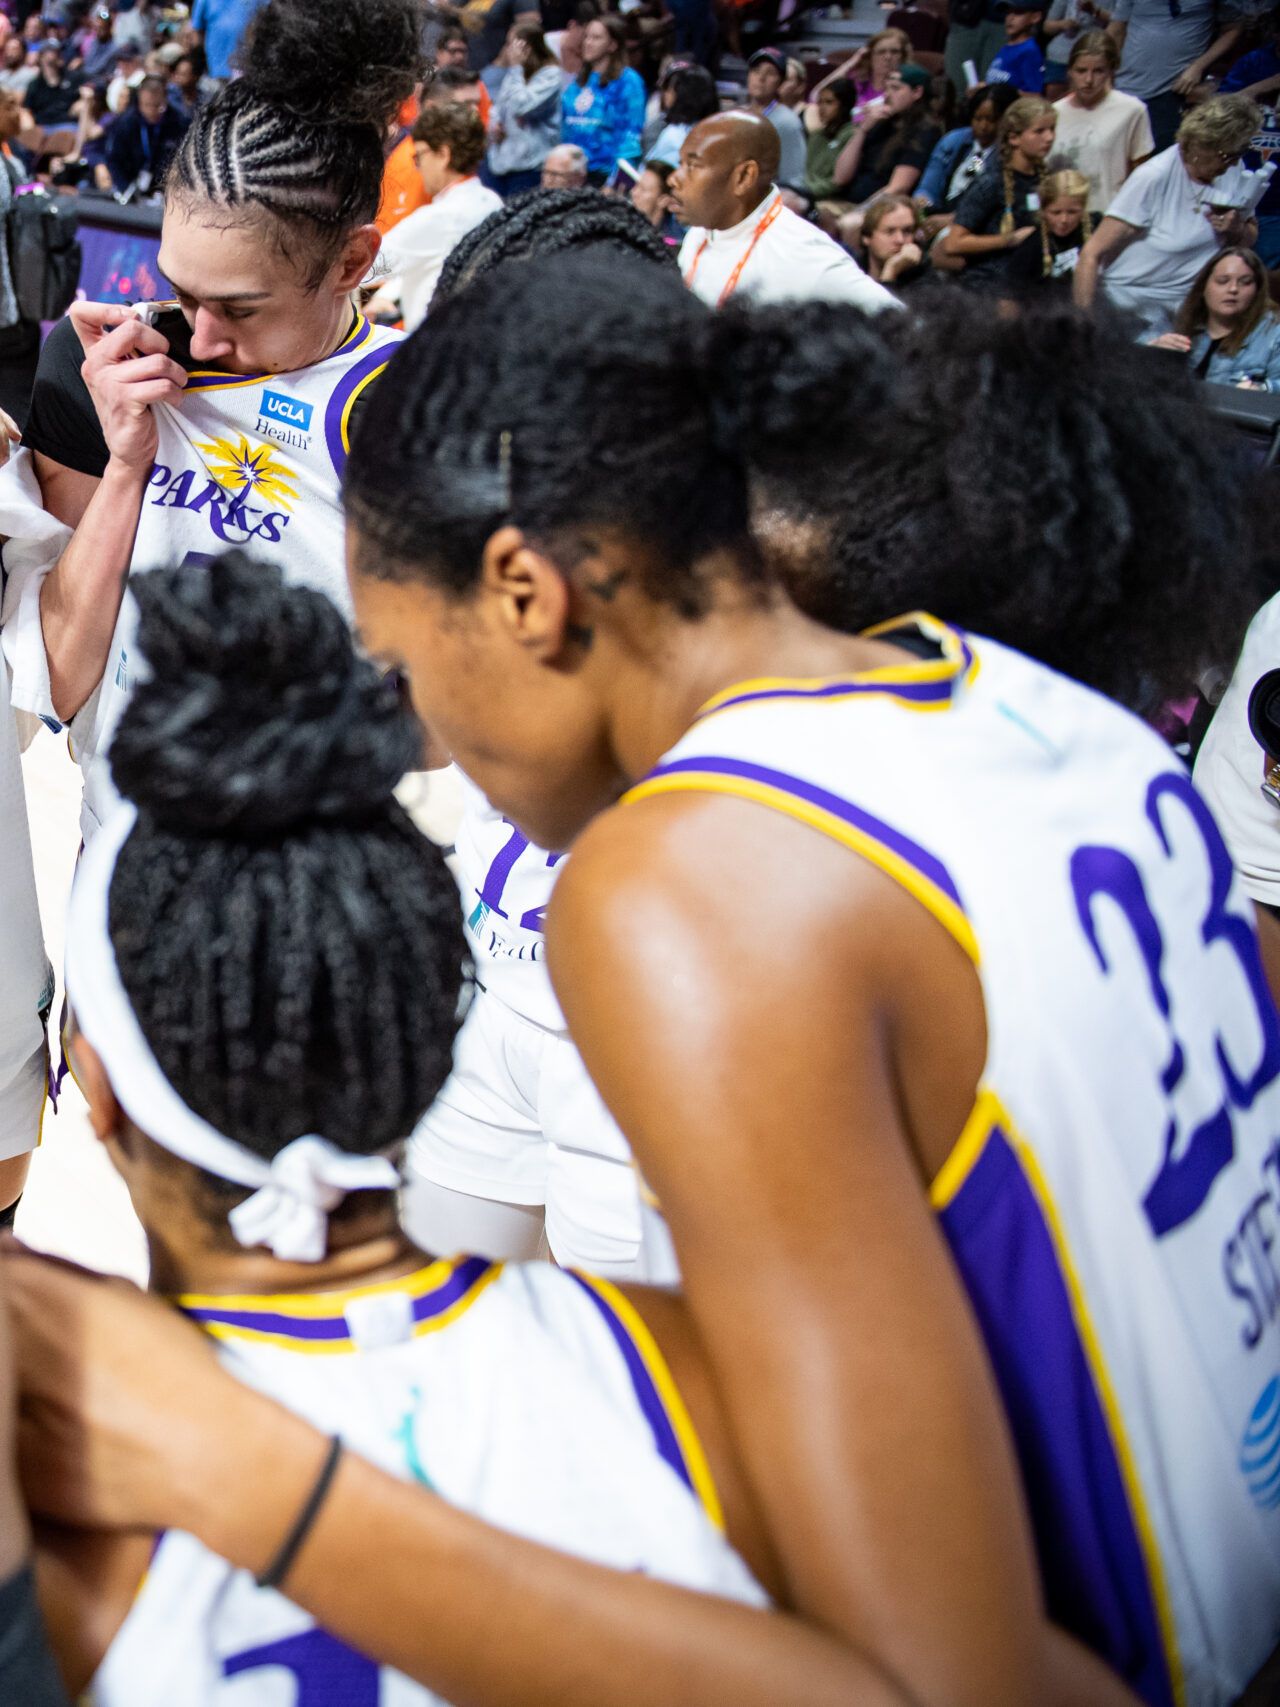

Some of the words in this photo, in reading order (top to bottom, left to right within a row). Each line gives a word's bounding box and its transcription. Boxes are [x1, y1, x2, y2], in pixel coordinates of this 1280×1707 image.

[267, 397, 305, 423] UCLA
[255, 418, 308, 450] Health
[1069, 770, 1280, 1240] 23
